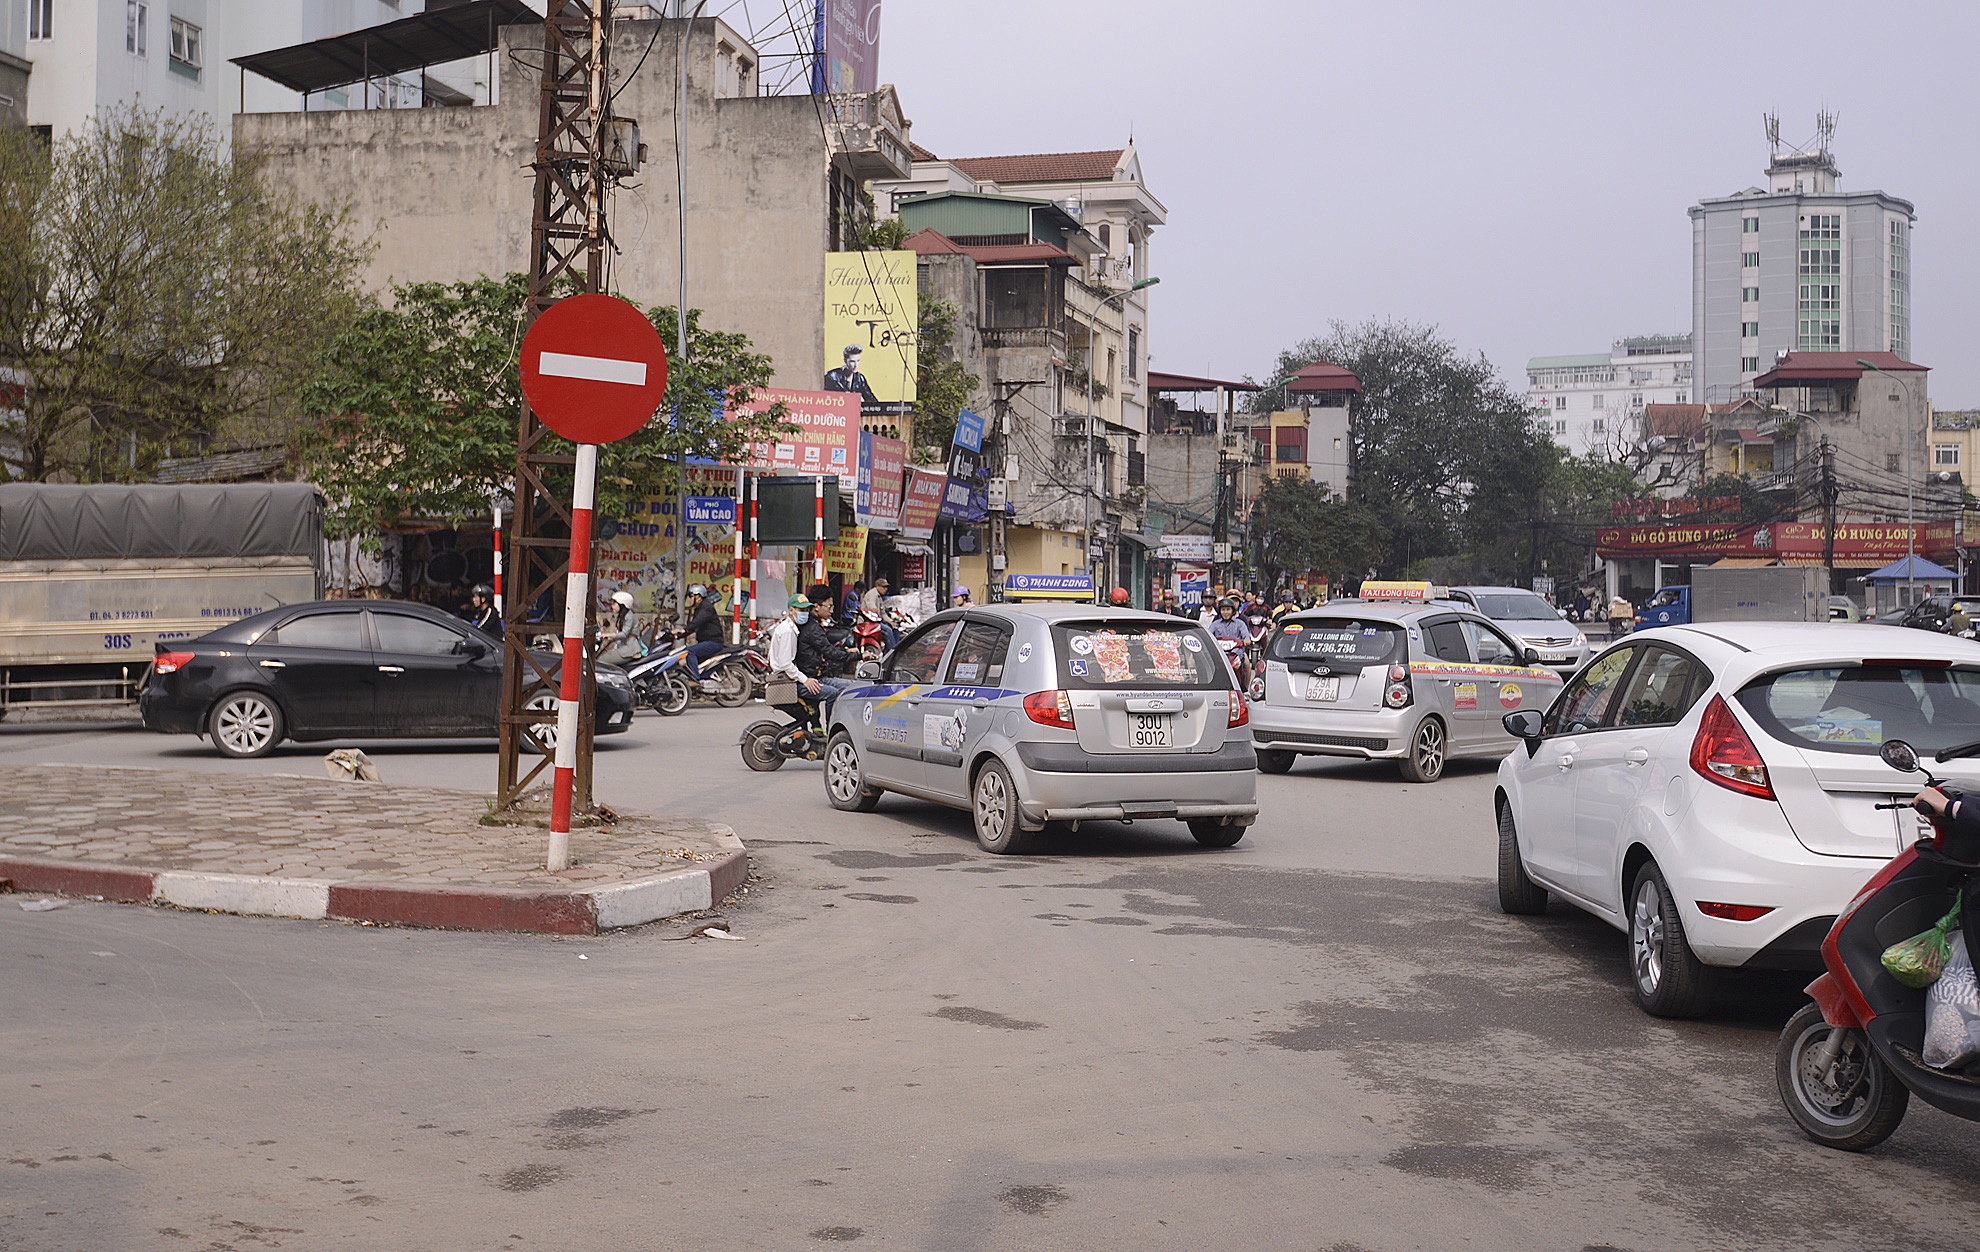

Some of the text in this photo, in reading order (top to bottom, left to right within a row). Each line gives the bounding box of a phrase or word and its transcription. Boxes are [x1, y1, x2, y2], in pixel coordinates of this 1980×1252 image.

[832, 303, 859, 318] TẠO
[791, 410, 811, 425] BẢO
[711, 509, 731, 520] CAO
[617, 519, 697, 540] CHỤP ẢH
[828, 549, 846, 559] THAY
[847, 562, 856, 570] XE
[992, 594, 1001, 602] XE
[1363, 589, 1382, 597] TAXI
[1382, 589, 1402, 597] LONG
[104, 634, 132, 649] 30S
[1323, 633, 1339, 641] LONG
[1302, 642, 1357, 654] 38.736.736
[1315, 678, 1331, 688] 29A
[1306, 689, 1335, 700] 357.64
[1137, 715, 1162, 730] 30U
[1136, 731, 1166, 746] 9012
